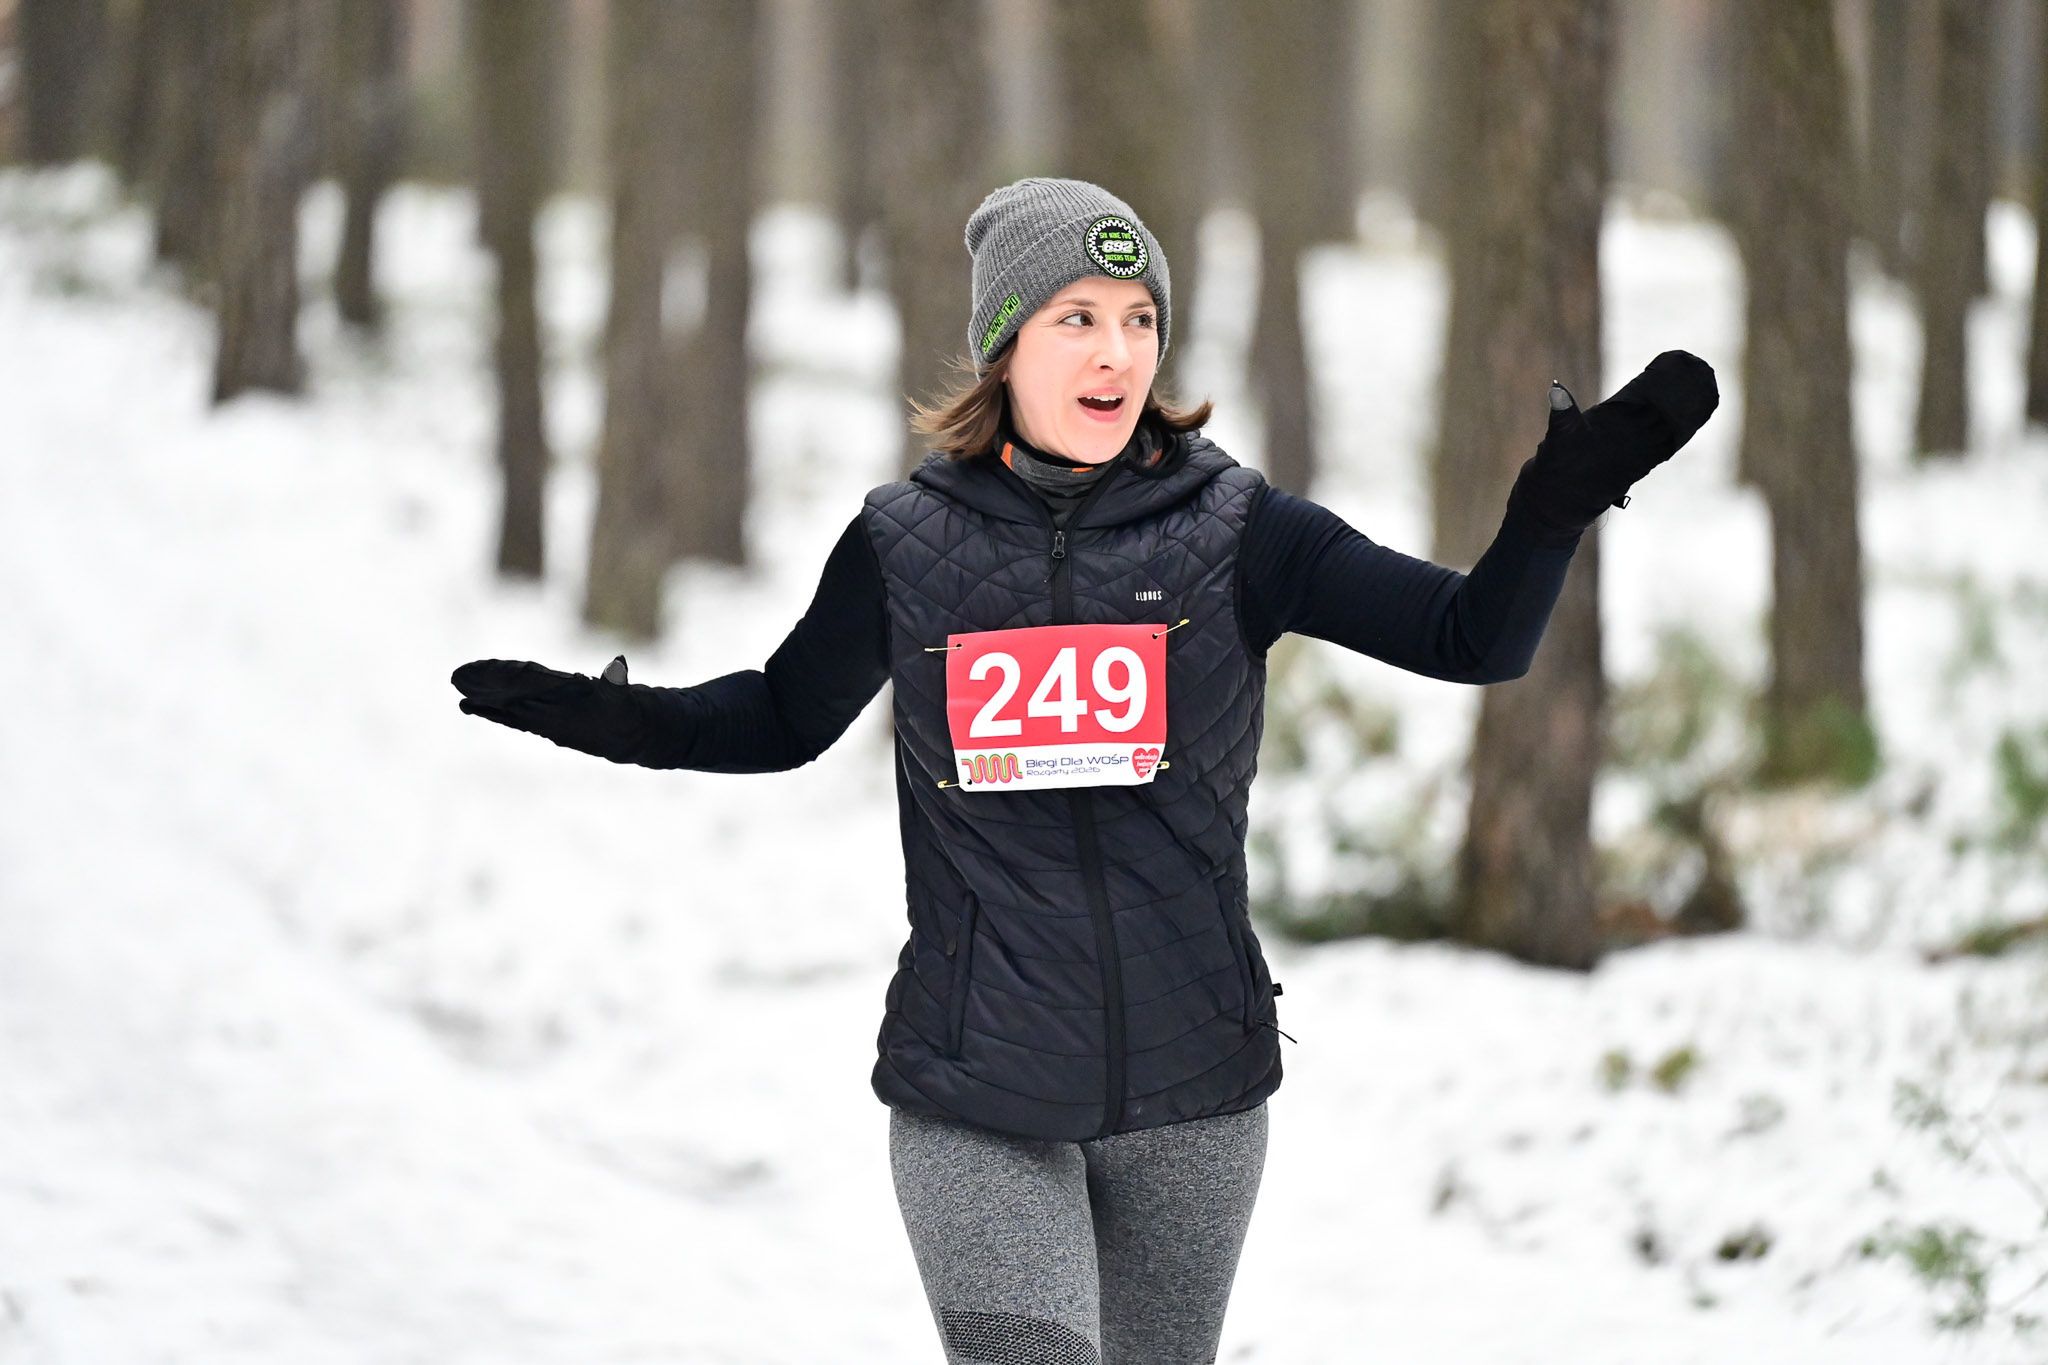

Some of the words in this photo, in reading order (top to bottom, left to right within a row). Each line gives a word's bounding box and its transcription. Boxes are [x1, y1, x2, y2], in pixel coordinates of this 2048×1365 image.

[1102, 240, 1134, 253] 692
[1002, 295, 1020, 317] TWO
[968, 646, 1148, 738] 249
[1025, 759, 1057, 769] Biegi
[1060, 757, 1083, 766] Dla
[1086, 754, 1130, 765] WOŚP
